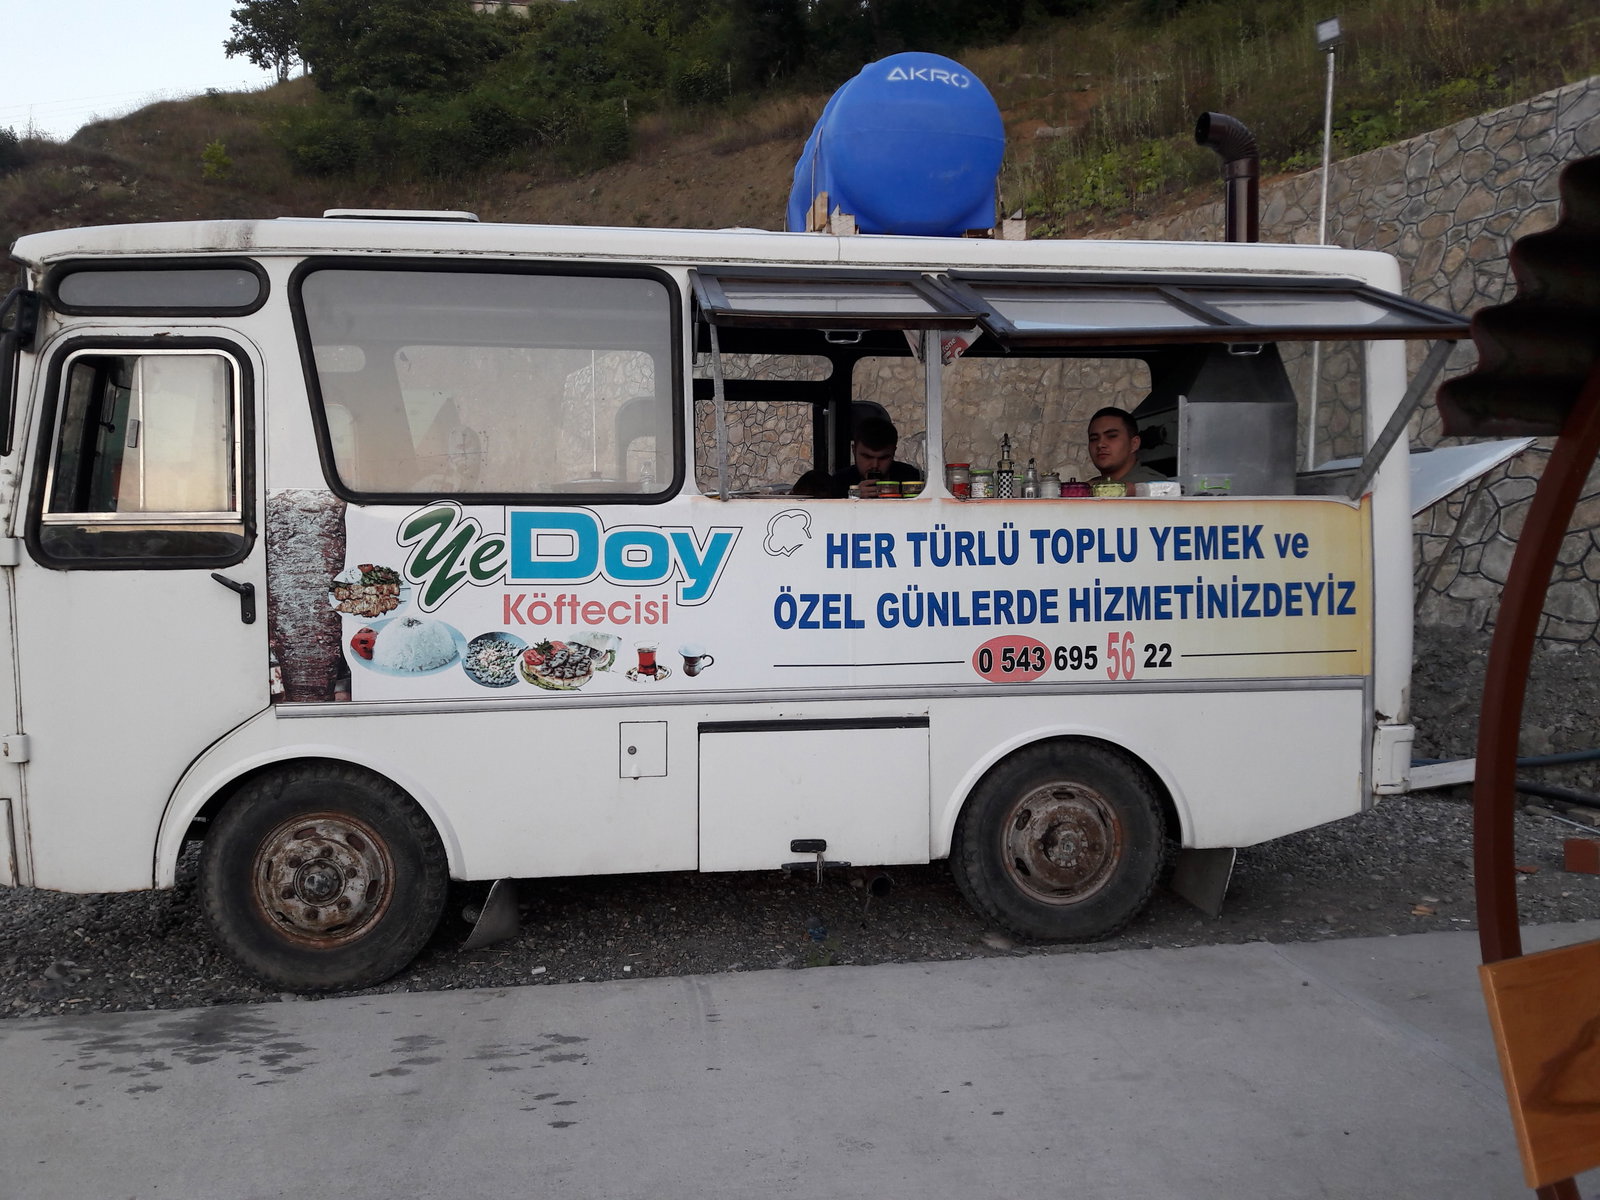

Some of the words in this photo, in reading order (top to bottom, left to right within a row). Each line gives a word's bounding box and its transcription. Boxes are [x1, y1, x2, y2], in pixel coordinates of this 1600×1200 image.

[886, 66, 970, 89] AKRO
[826, 532, 898, 569] HER
[906, 522, 1020, 568] TÜRLÜ
[1030, 527, 1138, 565] TOPLU
[1149, 525, 1266, 562] YEMEK
[1274, 532, 1310, 559] ve
[503, 593, 669, 625] Köftecisi
[773, 585, 866, 630] ÖZEL
[876, 584, 1060, 629] GÜNLERDE
[1069, 572, 1357, 624] HİZMETİNİZDEYİZ
[978, 647, 994, 674] 0
[1001, 646, 1046, 673] 543
[1053, 645, 1098, 671] 695
[1106, 630, 1136, 681] 56
[1143, 642, 1173, 669] 22
